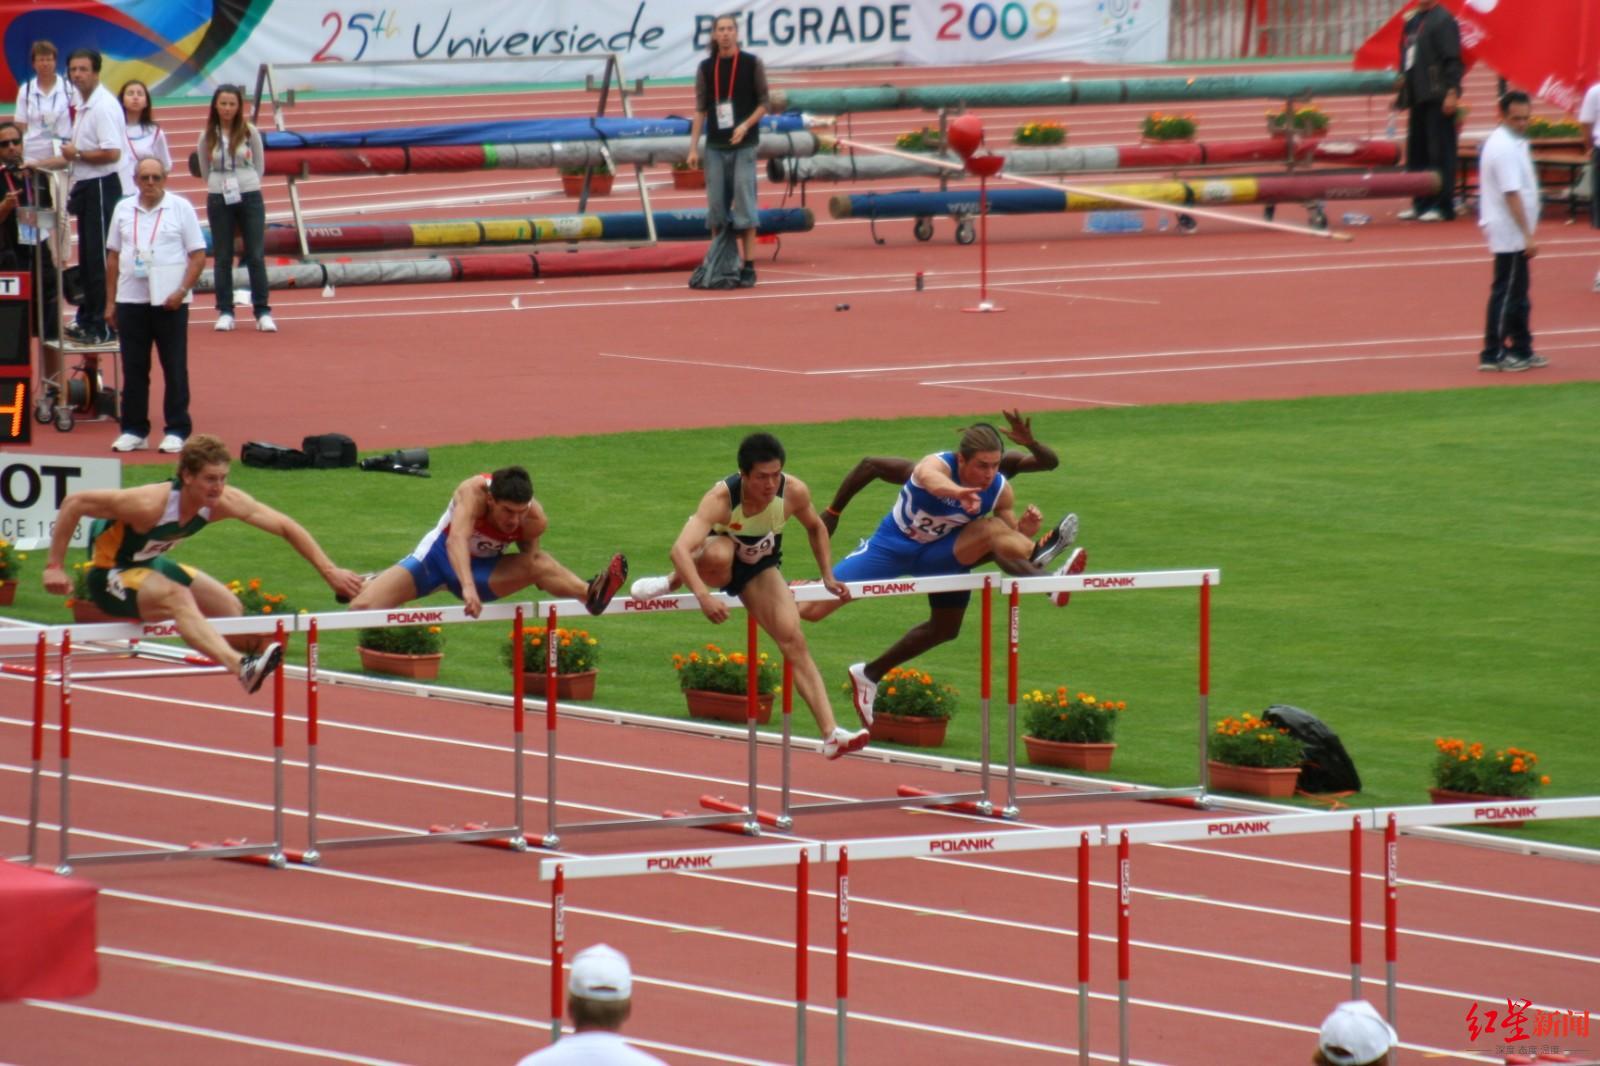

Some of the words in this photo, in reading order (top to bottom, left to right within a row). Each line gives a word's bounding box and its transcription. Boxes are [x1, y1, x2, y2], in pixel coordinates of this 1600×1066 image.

[412, 1, 664, 58] Universiade
[693, 4, 911, 51] BLGRADE
[936, 2, 1060, 42] 2009
[38, 520, 83, 541] 183
[919, 517, 947, 536] 24
[744, 538, 771, 557] 59
[863, 582, 917, 595] POLANIK
[1083, 577, 1135, 588] POLANIK
[625, 599, 680, 611] POLANIK
[387, 611, 443, 624] POLANIK
[1475, 807, 1537, 820] POLANIK
[1207, 821, 1271, 835] POLANIK
[929, 837, 996, 852] POLANIK
[646, 855, 713, 870] POLANIK
